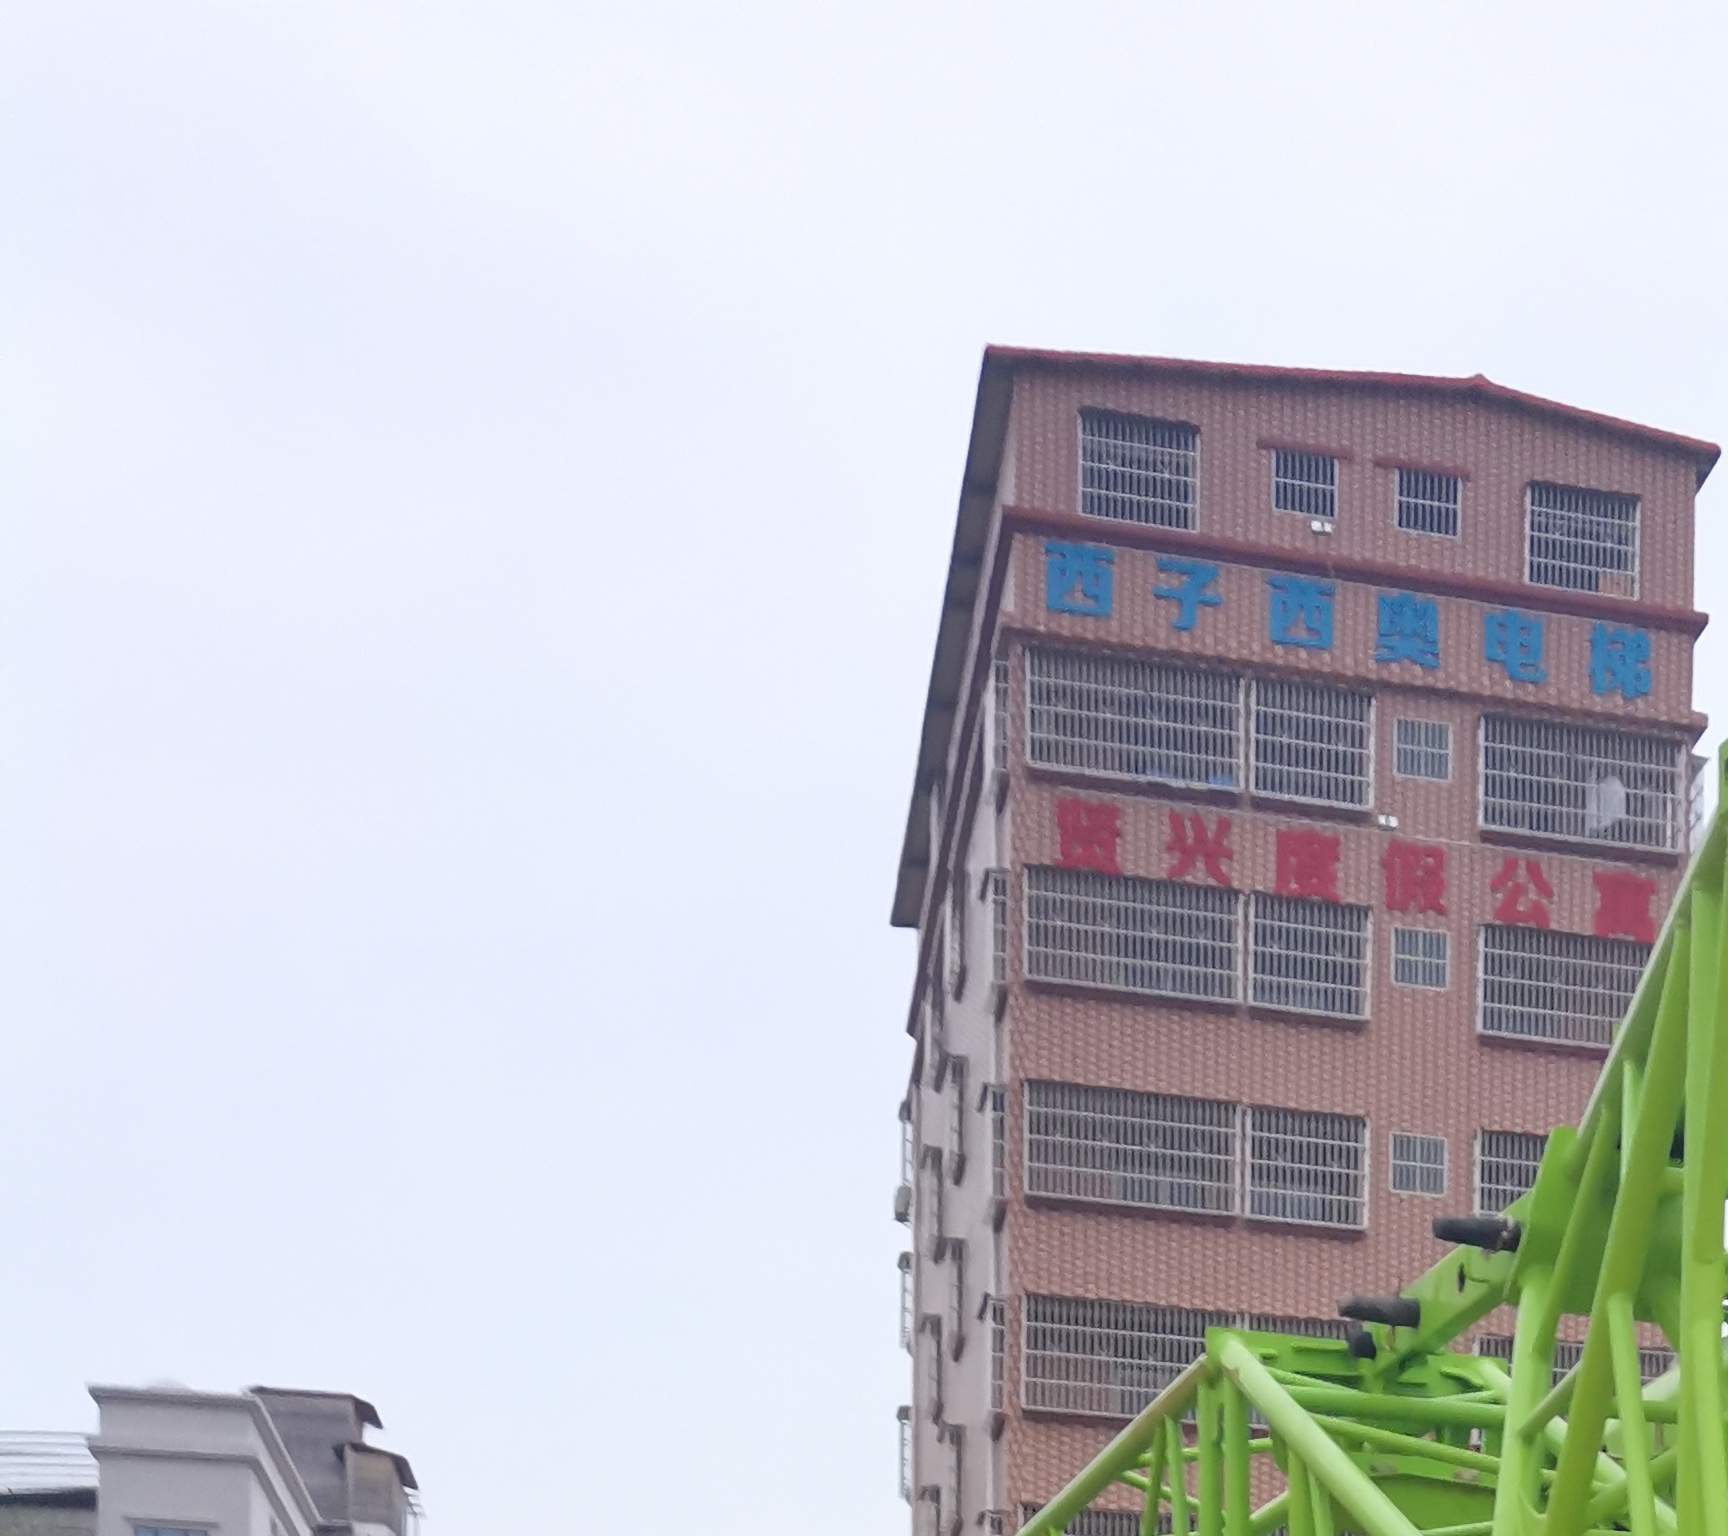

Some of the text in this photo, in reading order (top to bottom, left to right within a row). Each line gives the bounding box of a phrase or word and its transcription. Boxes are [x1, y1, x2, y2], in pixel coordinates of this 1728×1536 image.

[1044, 537, 1652, 700] 西子西奥电梯
